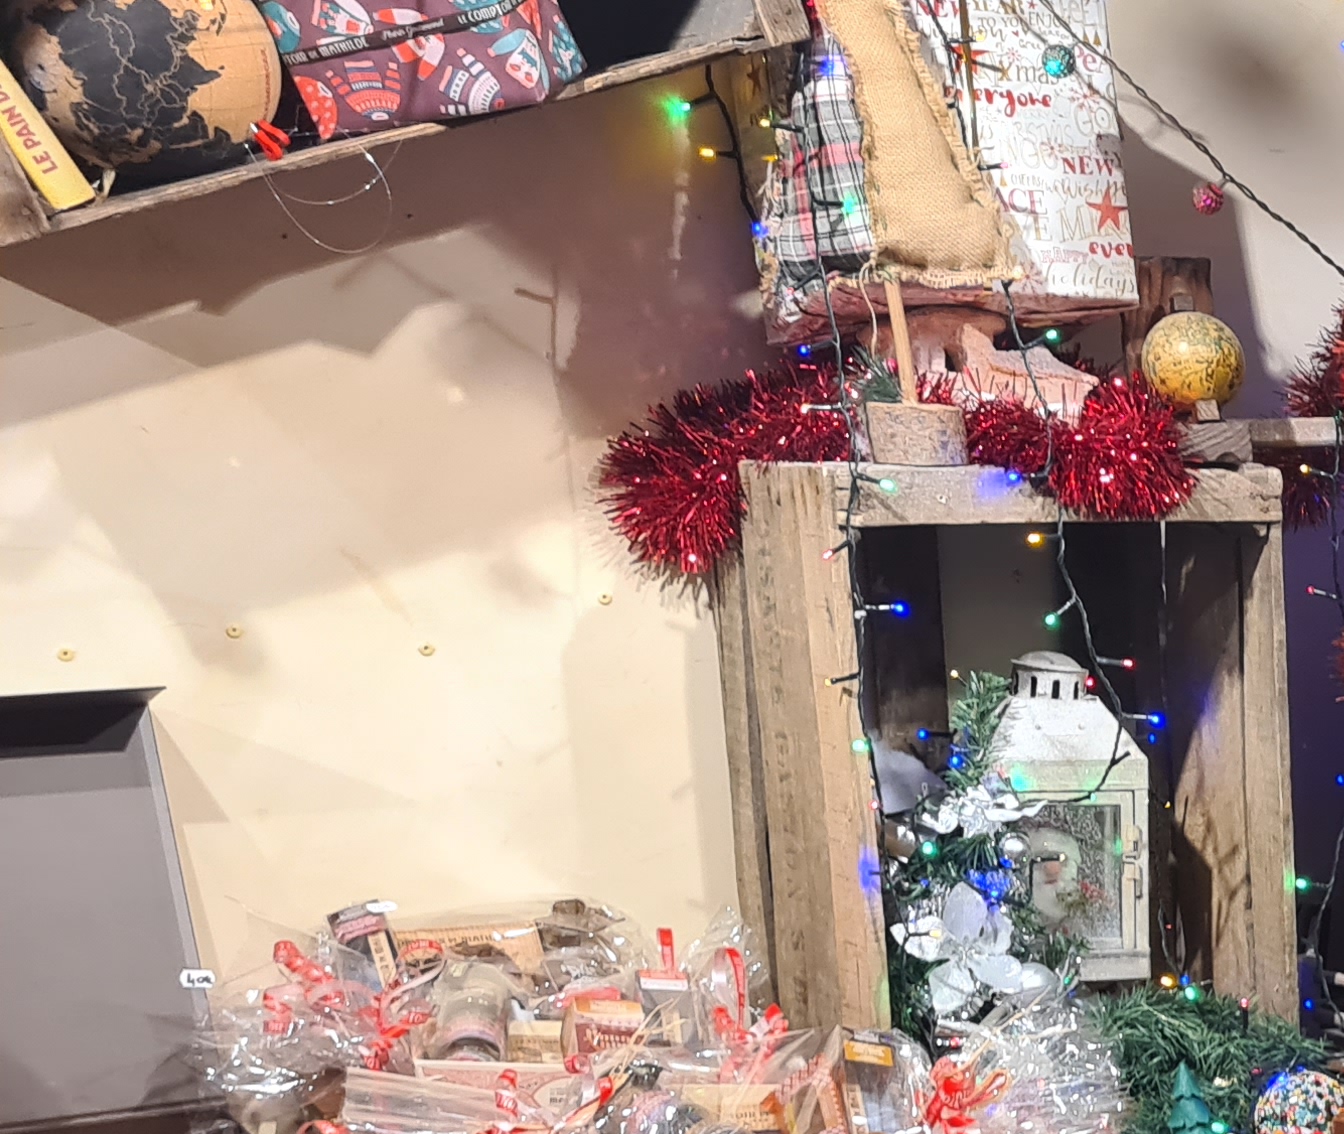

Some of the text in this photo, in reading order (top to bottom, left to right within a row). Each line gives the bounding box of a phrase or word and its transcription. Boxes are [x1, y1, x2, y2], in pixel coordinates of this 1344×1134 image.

[319, 36, 370, 57] MATHILDE
[2, 105, 42, 150] PAIN
[32, 151, 58, 174] LE
[1062, 155, 1115, 177] NEW
